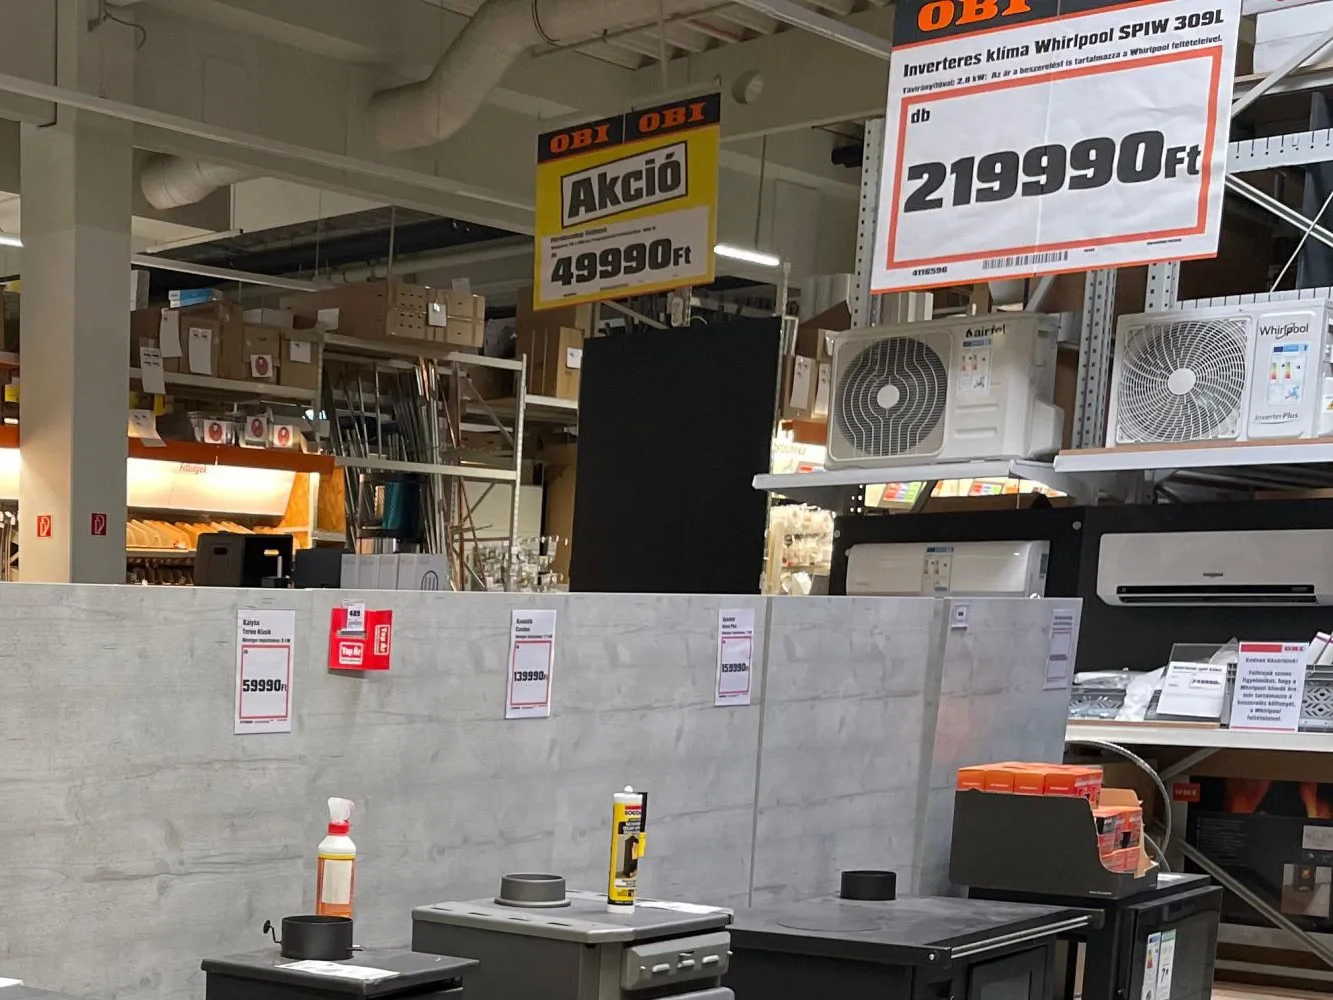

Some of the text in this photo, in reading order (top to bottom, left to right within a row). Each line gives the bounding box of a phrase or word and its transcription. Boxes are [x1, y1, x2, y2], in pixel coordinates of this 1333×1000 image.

[903, 9, 1224, 77] Inverteres klíma Whirlpool SPIW 309L
[1019, 61, 1064, 74] beszerelést
[1074, 52, 1120, 65] tartalmazza
[1130, 43, 1169, 56] Whirlpool
[1172, 34, 1223, 49] feltételeivel.
[550, 101, 707, 153] OBI OBI
[911, 108, 930, 124] db
[568, 152, 681, 219] Akció
[903, 130, 1202, 215] 219990Ft
[551, 238, 691, 286] 49990Ft
[912, 266, 948, 276] 4116596
[1259, 322, 1309, 340] Whirlpool
[379, 627, 388, 642] Top
[342, 645, 362, 656] Top Ár
[242, 679, 287, 692] 59990Ft
